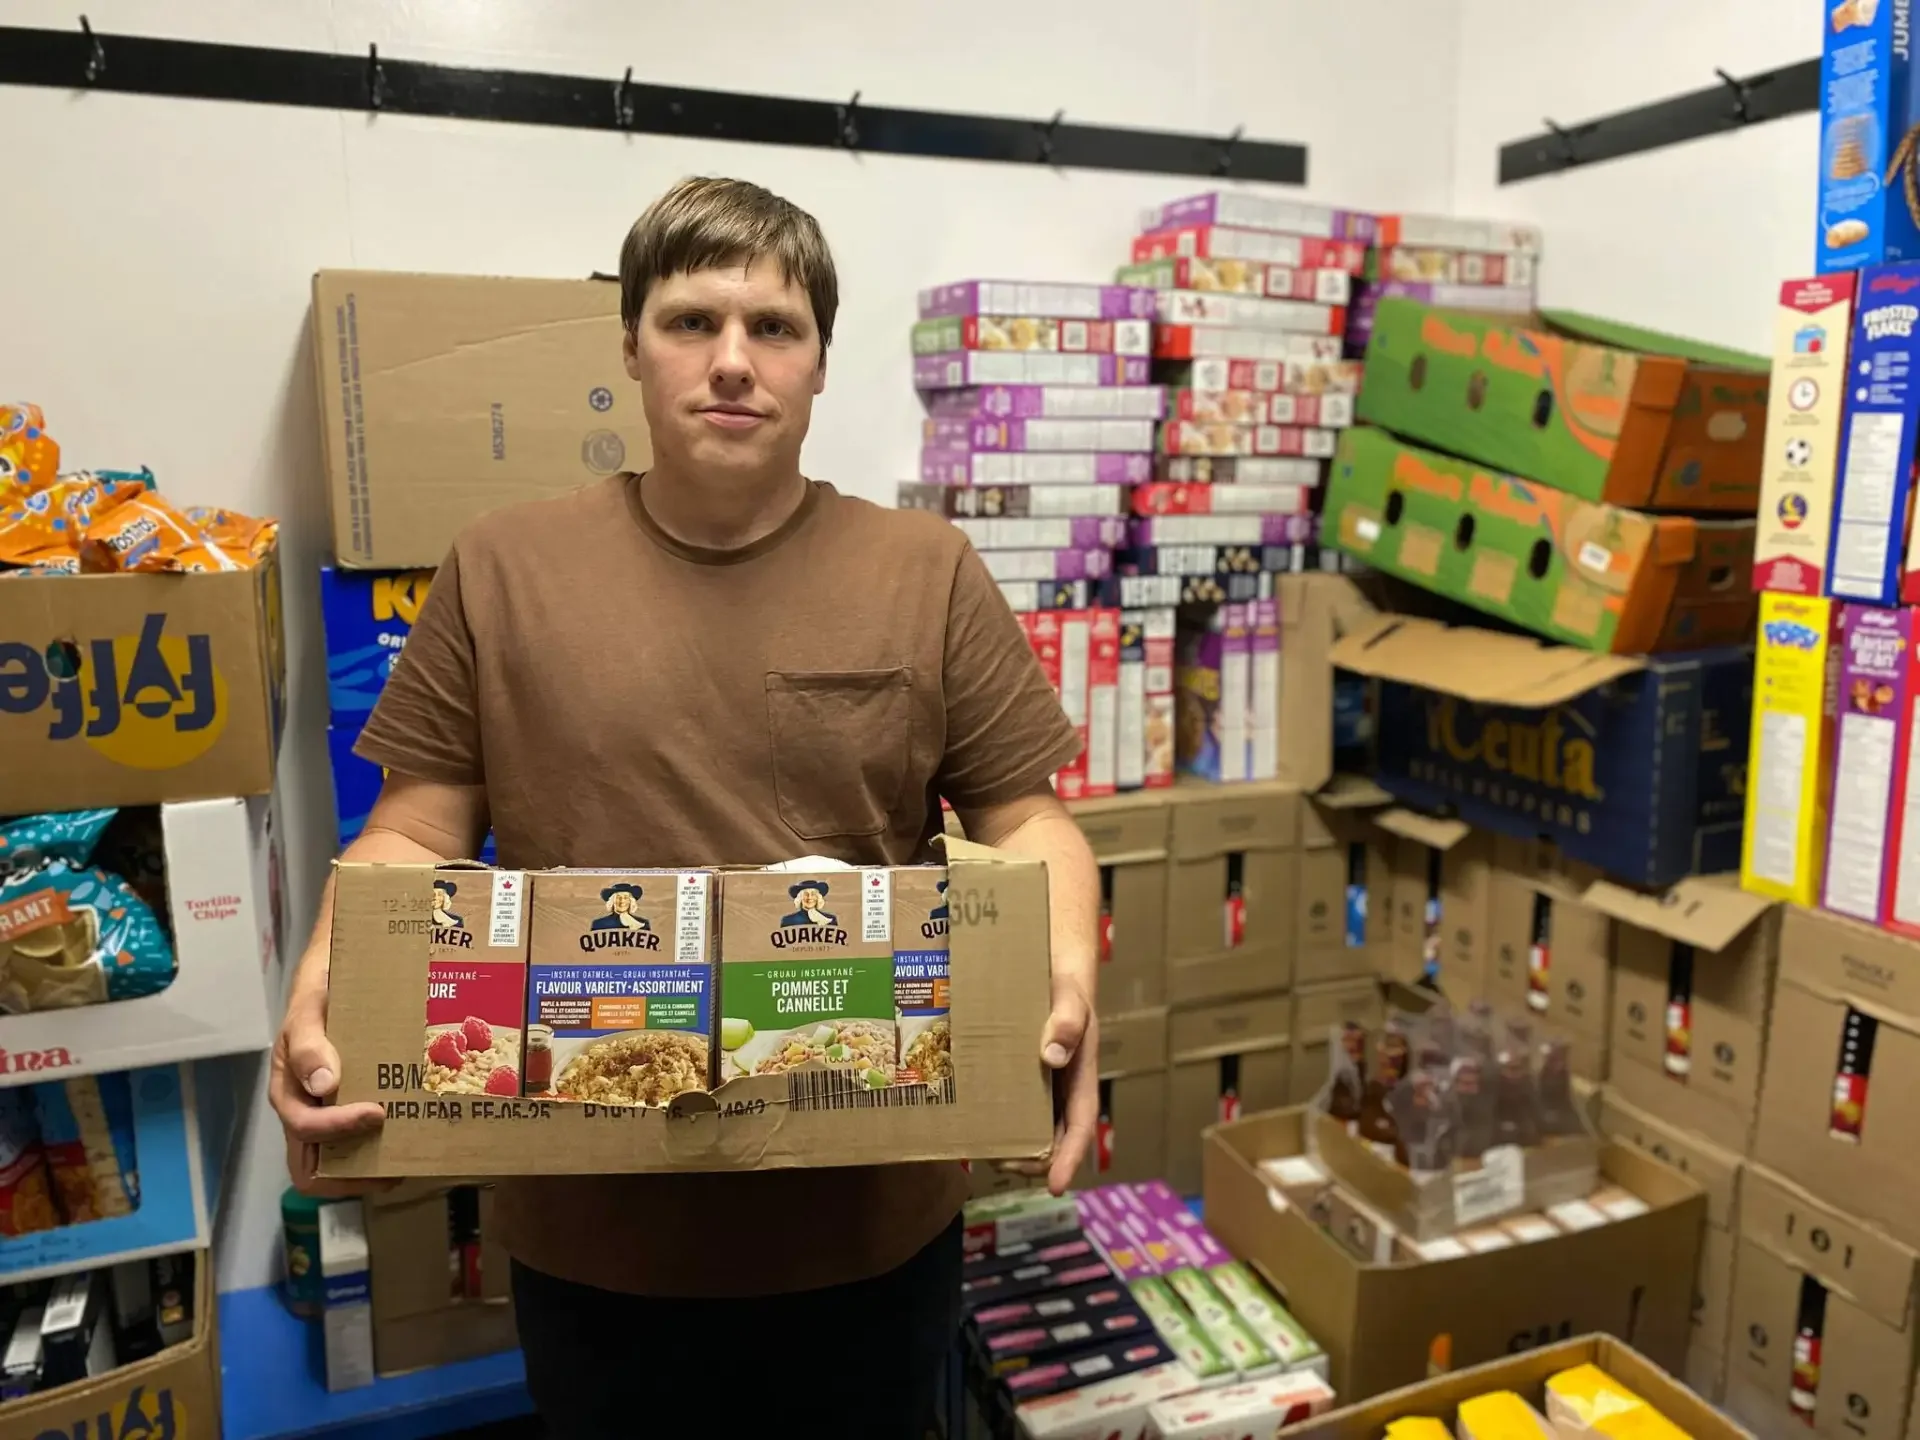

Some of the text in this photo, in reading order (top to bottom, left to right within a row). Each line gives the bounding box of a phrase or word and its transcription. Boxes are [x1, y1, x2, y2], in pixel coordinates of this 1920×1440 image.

[184, 895, 242, 911] Tortilla
[193, 908, 238, 920] Chips
[579, 930, 661, 952] QUAKER
[770, 927, 848, 948] QUAKER
[551, 971, 579, 979] INSTANT
[583, 971, 613, 979] OATMEAL
[650, 969, 691, 978] INSTANTANÉ
[767, 967, 854, 978] GRUAU INSTANTANÉ
[429, 983, 457, 998] URE
[536, 981, 582, 995] FLAVOUR
[771, 979, 849, 996] POMMES ET
[776, 996, 844, 1013] CANNELLE
